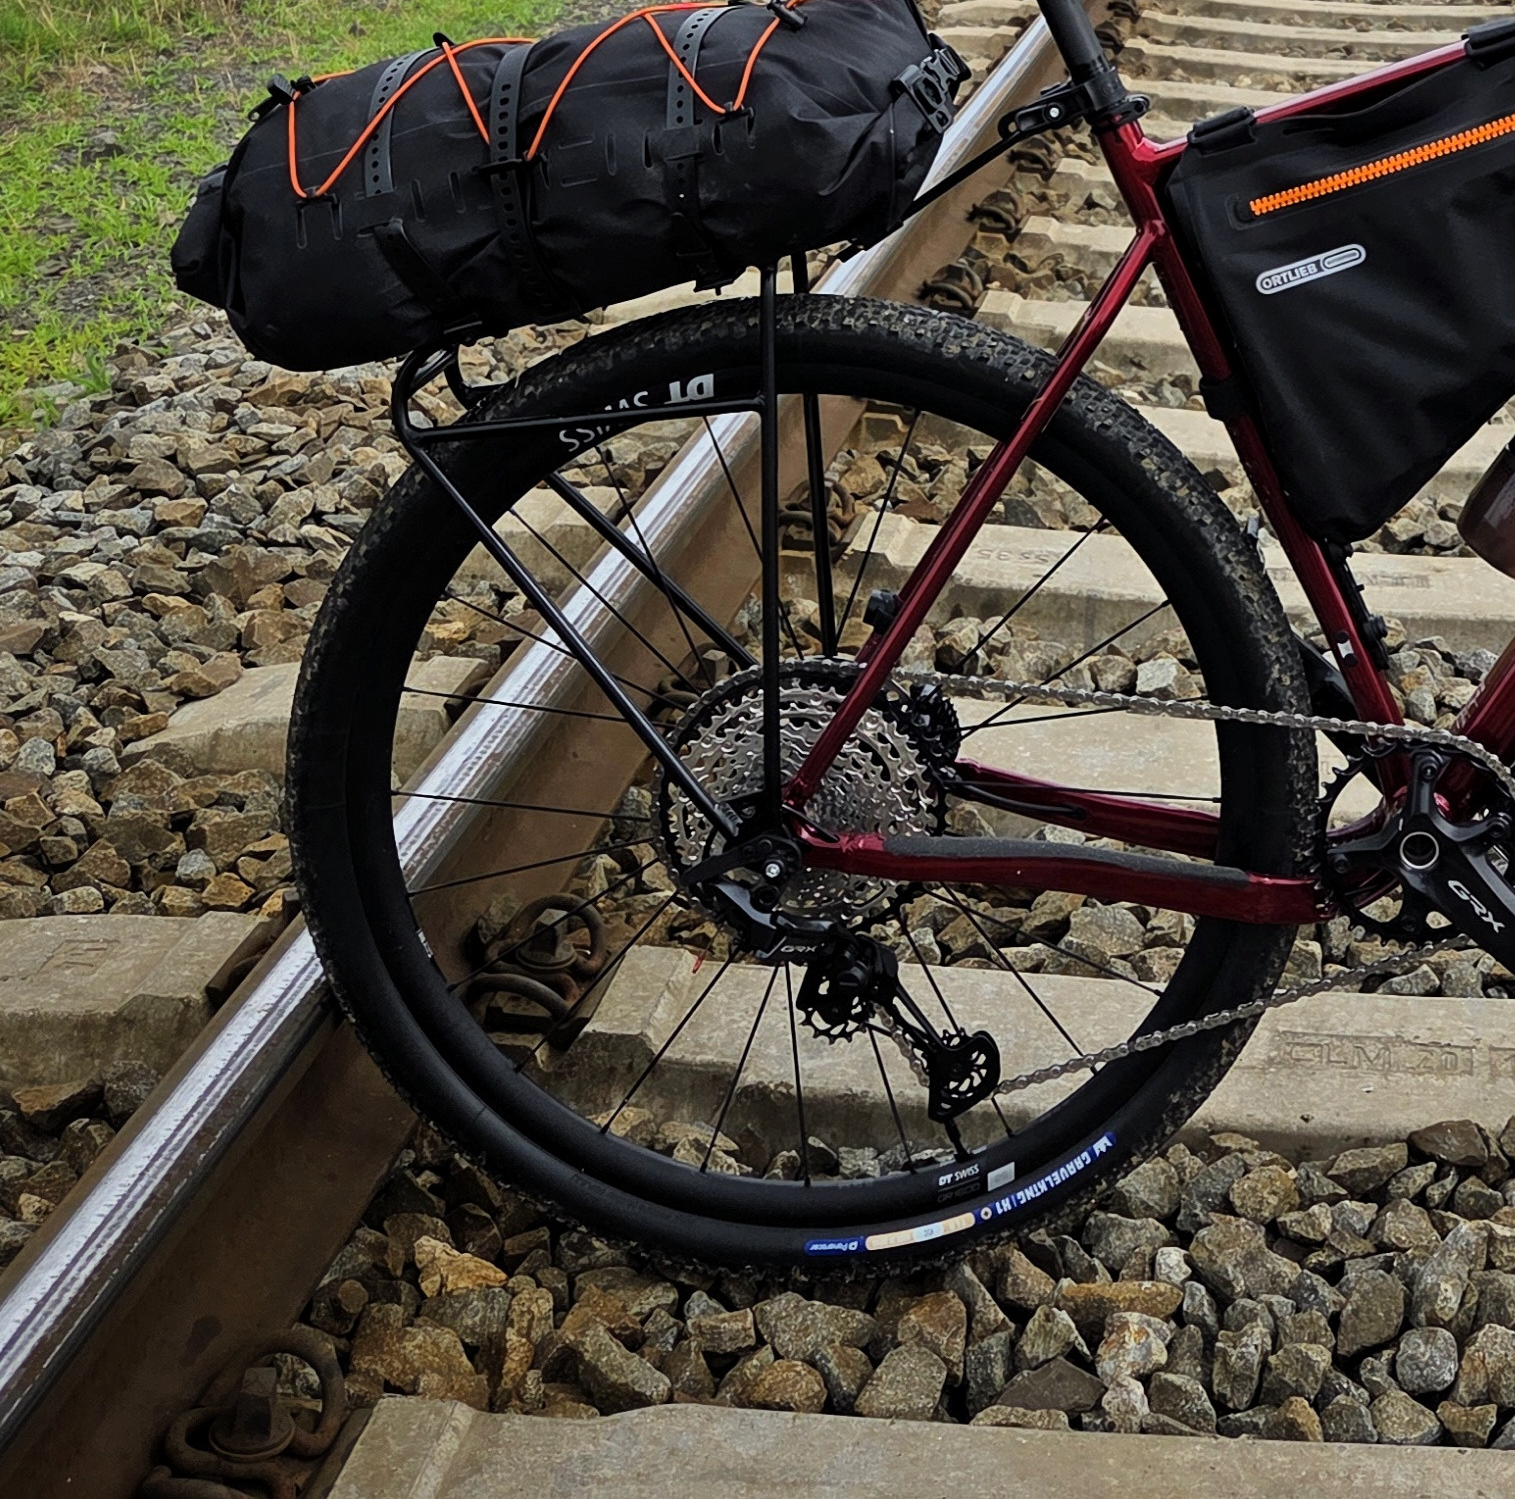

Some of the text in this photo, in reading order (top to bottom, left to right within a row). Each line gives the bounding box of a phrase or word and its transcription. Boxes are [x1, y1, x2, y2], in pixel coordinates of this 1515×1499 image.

[1262, 263, 1318, 289] ORTLIEB
[1448, 880, 1505, 933] GRX
[938, 1163, 979, 1186] DT SWISS
[1016, 1151, 1092, 1205] GRAVELKING
